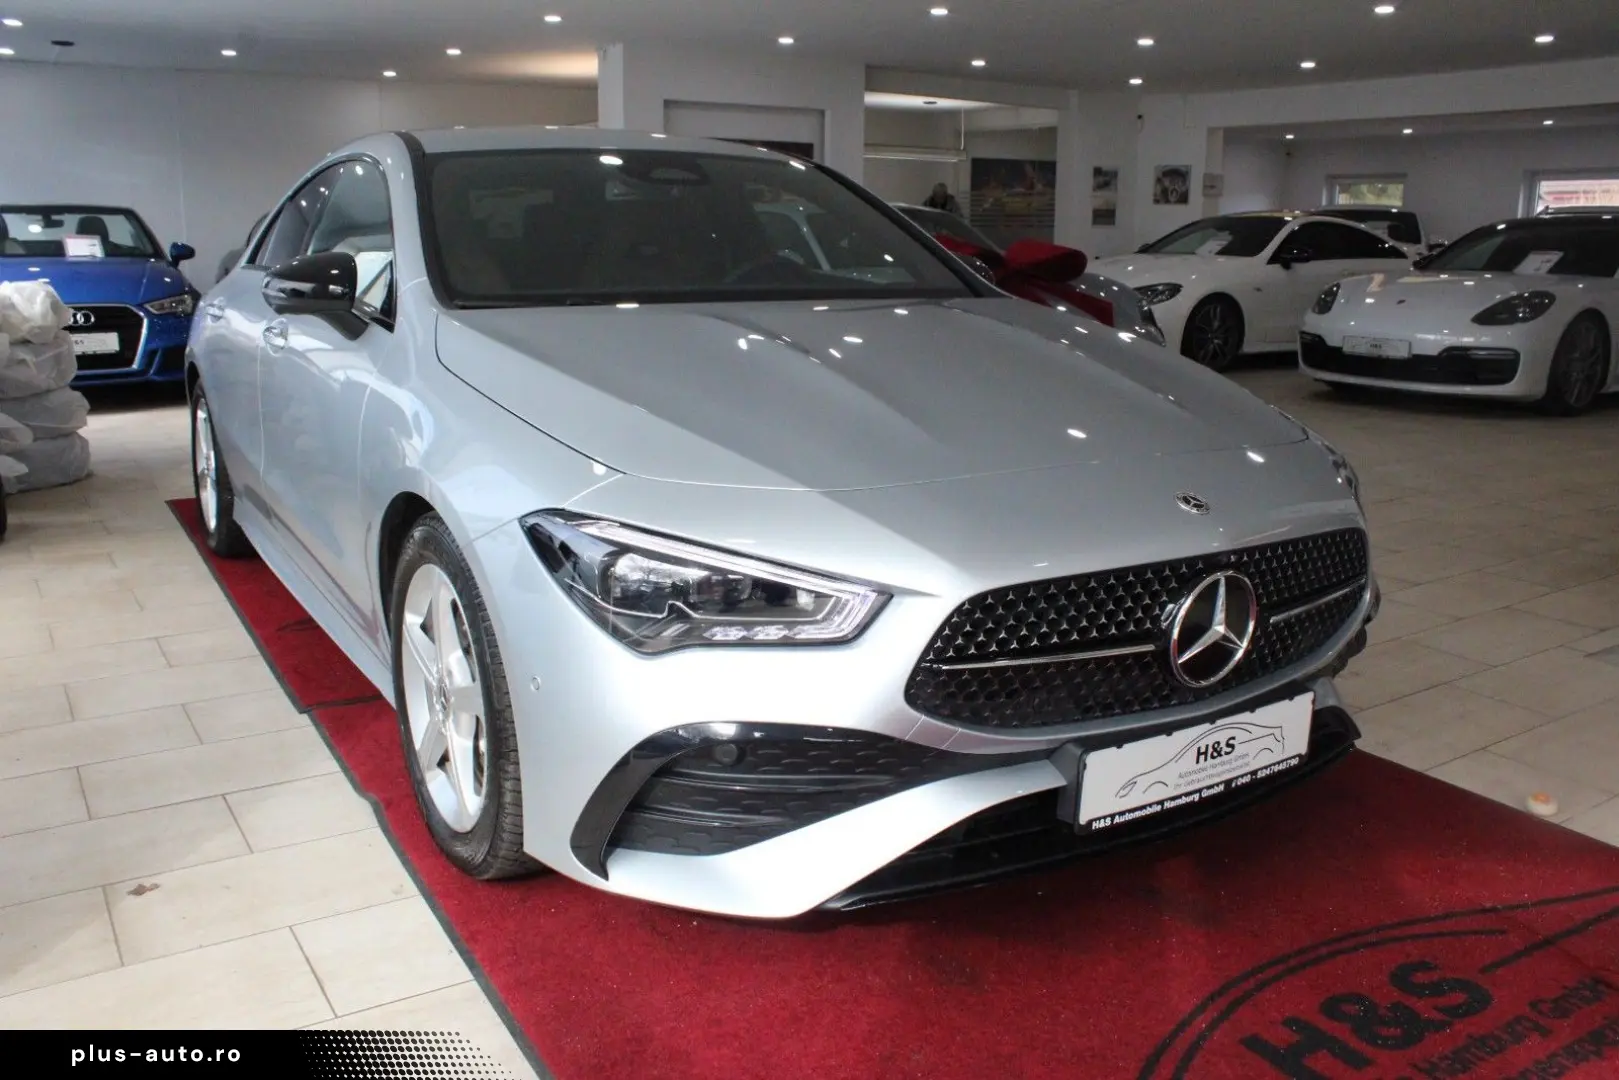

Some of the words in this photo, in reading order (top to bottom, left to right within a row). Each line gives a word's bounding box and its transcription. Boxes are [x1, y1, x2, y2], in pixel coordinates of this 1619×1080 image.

[1195, 736, 1236, 764] H&S
[1092, 817, 1111, 830] H&S
[1113, 804, 1162, 825] Automobile
[1163, 791, 1199, 809] Hamburg
[1201, 783, 1225, 798] GmbH
[1239, 960, 1493, 1080] H&S
